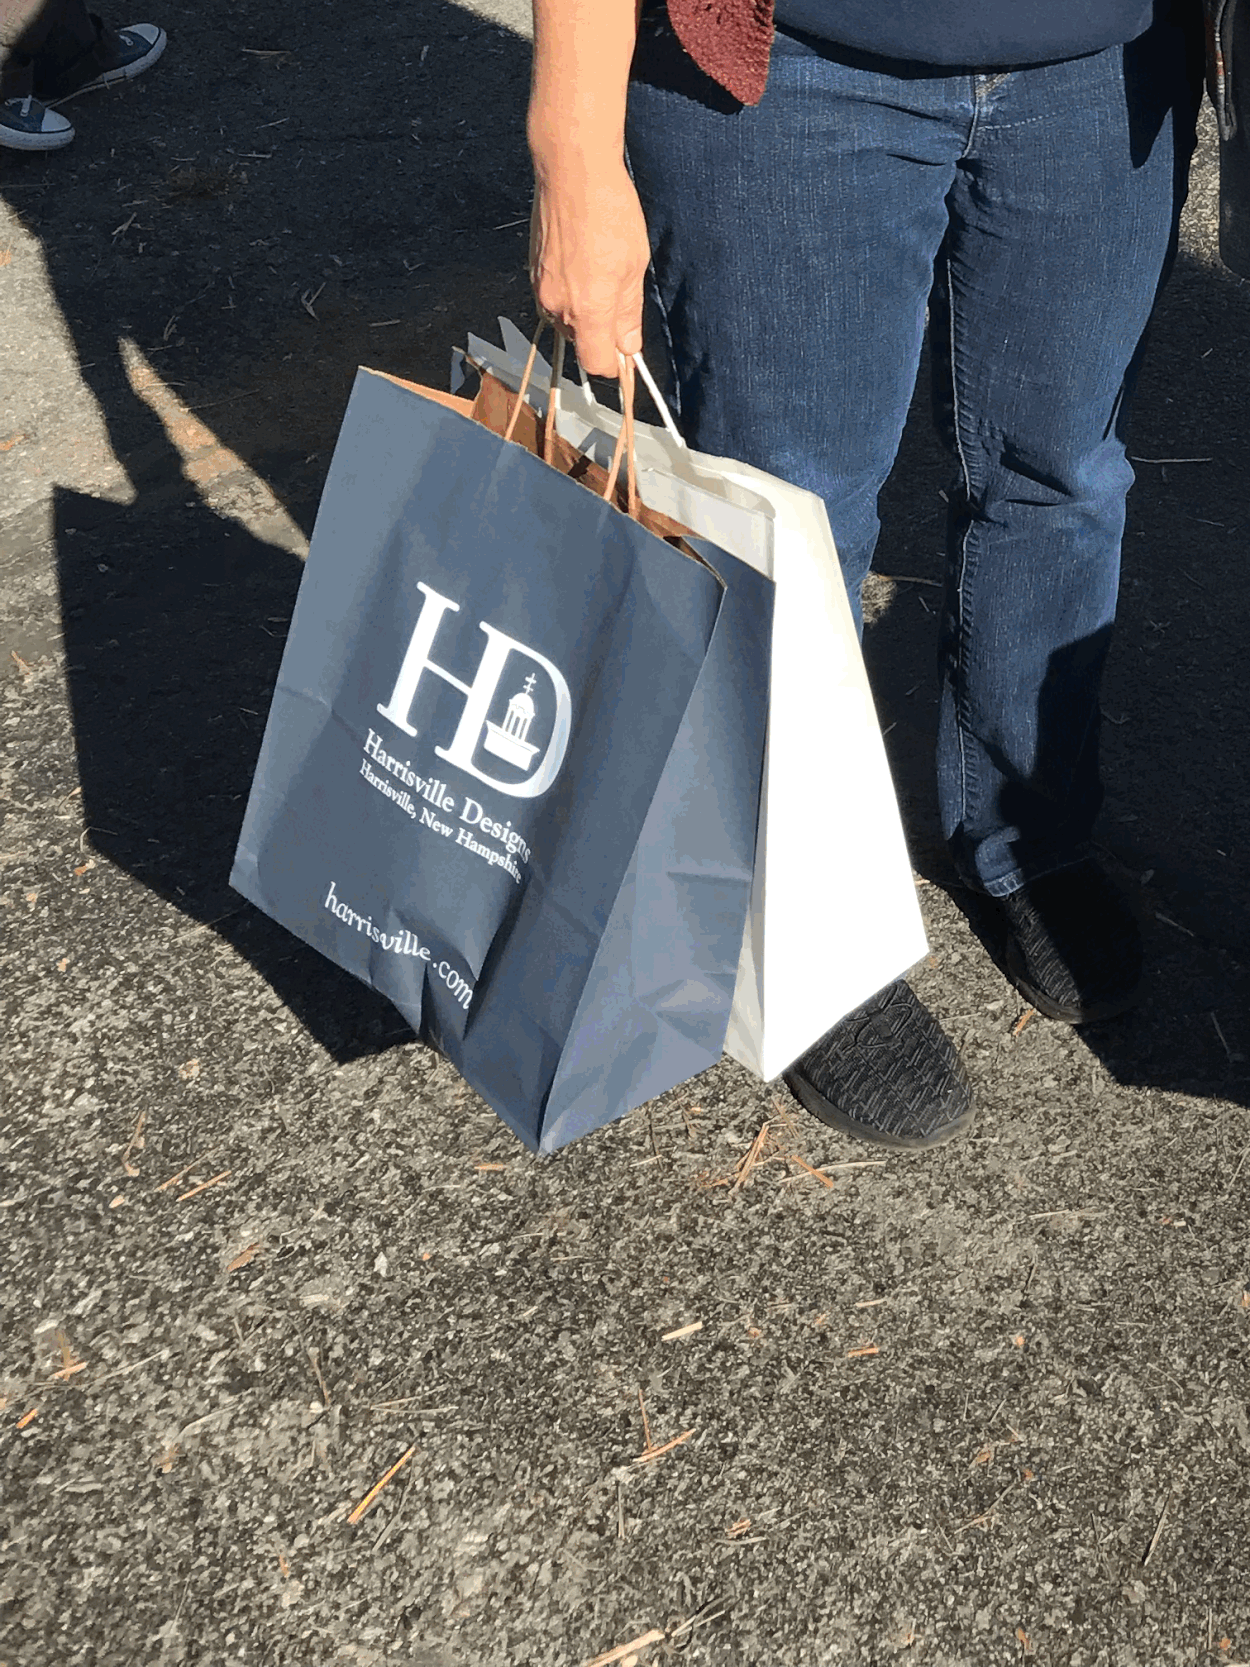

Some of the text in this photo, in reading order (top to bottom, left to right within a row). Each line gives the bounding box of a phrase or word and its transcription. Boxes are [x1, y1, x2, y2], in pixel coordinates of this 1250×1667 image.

[359, 758, 522, 884] Harrisville, New Hampshire
[363, 729, 531, 864] Harrisville Designs
[324, 881, 474, 1009] harrisville.com
